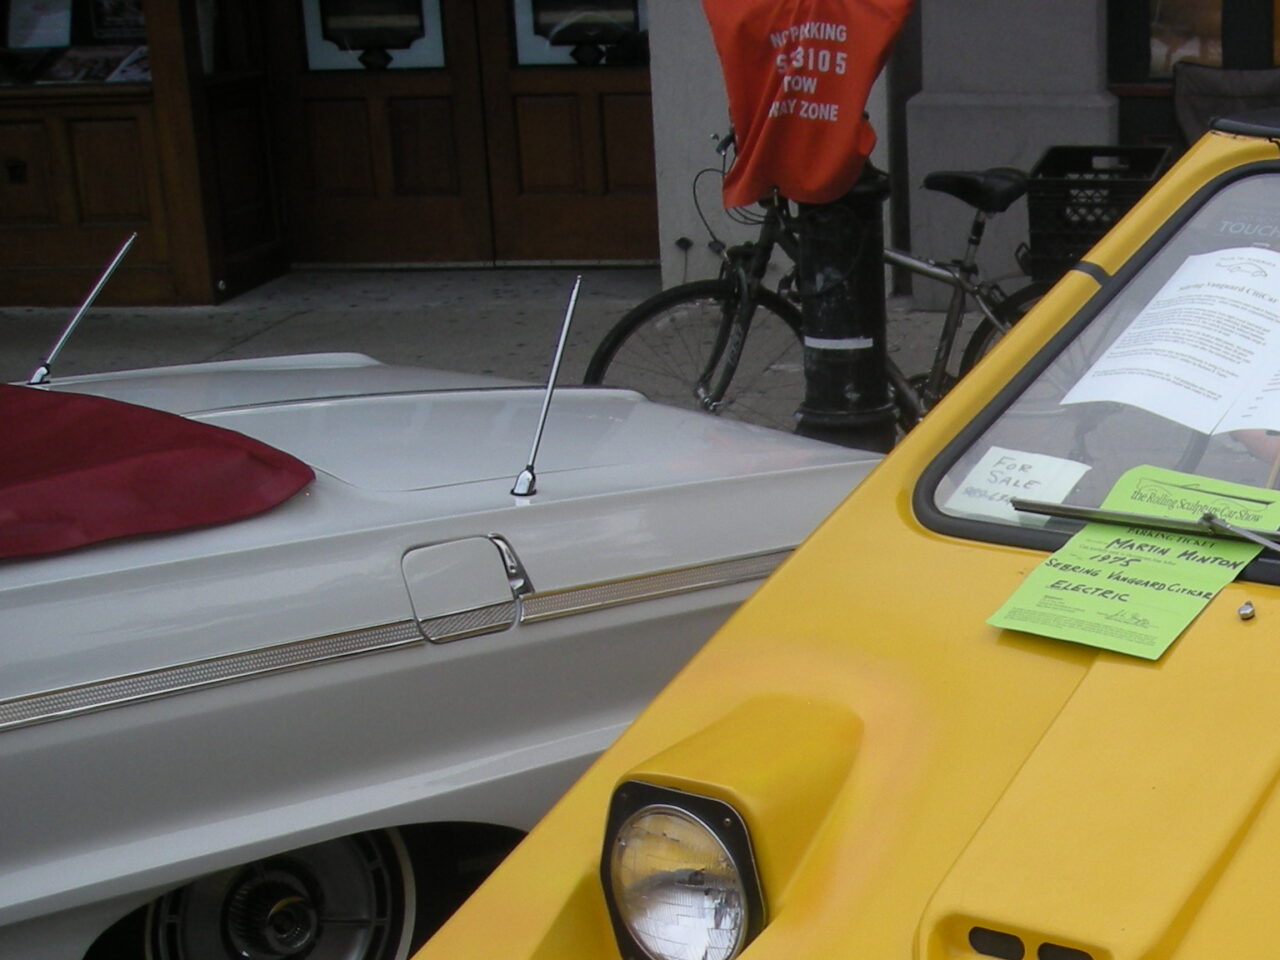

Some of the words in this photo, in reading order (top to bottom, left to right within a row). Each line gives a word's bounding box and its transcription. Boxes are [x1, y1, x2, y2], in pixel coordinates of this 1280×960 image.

[800, 100, 839, 121] ZONE
[993, 456, 1033, 472] FOR
[987, 470, 1042, 489] SALE
[1131, 488, 1147, 502] the
[1146, 492, 1178, 510] Rolling
[1220, 506, 1238, 519] Car
[1237, 509, 1263, 522] Show
[1106, 538, 1171, 556] MARTIN
[1127, 528, 1173, 542] PARKING
[1178, 535, 1217, 548] TICKET
[1089, 554, 1141, 567] 1975
[1045, 559, 1099, 577] SEBRING
[1107, 571, 1166, 591] VANGUARD
[1050, 579, 1130, 602] ELECTRIC
